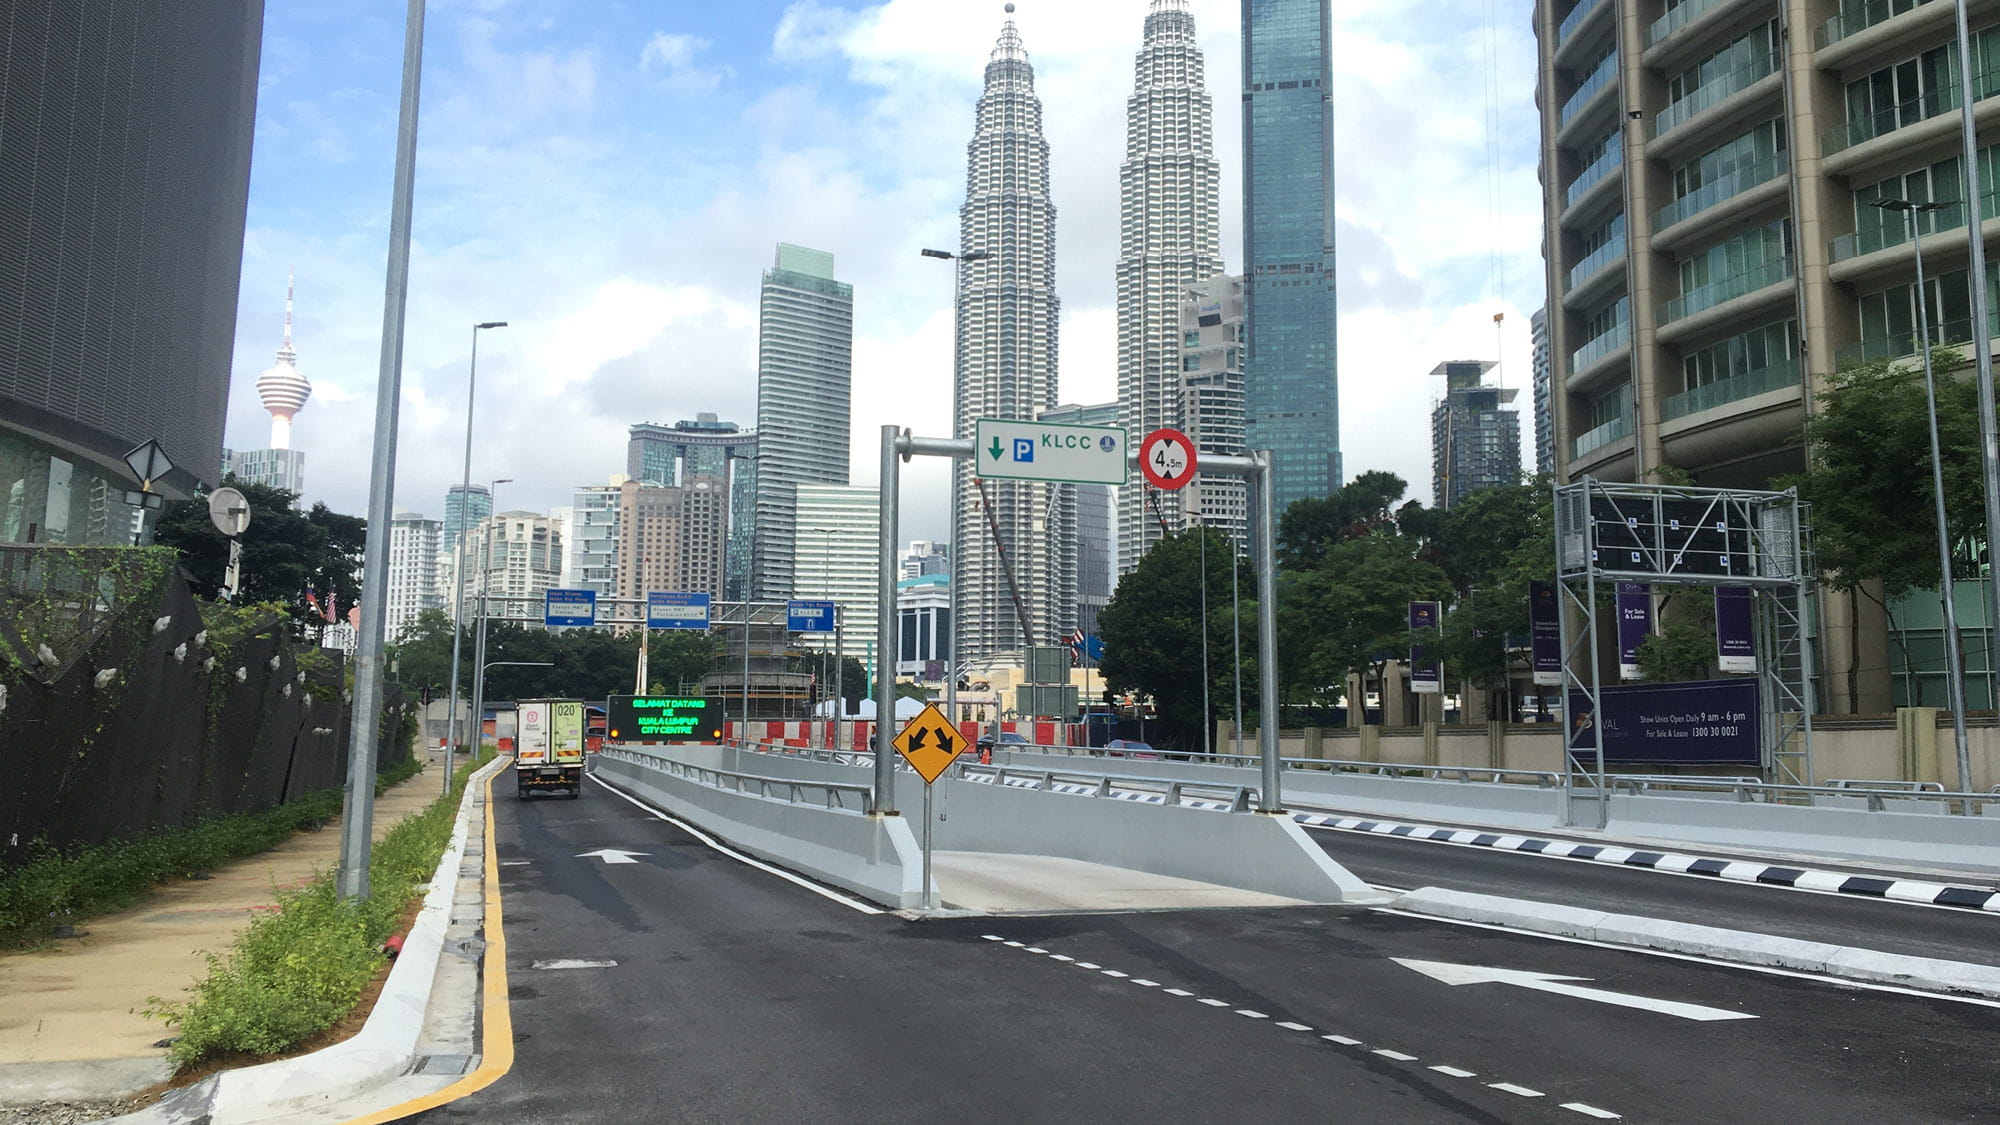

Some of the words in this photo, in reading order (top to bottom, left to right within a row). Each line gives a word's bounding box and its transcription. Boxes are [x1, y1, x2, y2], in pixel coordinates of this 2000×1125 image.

[1016, 442, 1026, 460] P
[1042, 434, 1091, 450] KLCC
[1155, 450, 1182, 468] 4.5m
[558, 705, 575, 716] 020
[1670, 715, 1684, 724] Open
[1686, 714, 1700, 724] Daily
[1701, 712, 1706, 721] 9
[1726, 711, 1731, 720] 6
[1733, 713, 1746, 723] pm
[1601, 719, 1619, 730] VAL
[1692, 727, 1708, 736] 1300
[1711, 727, 1719, 736] 30
[1722, 726, 1738, 736] 0021
